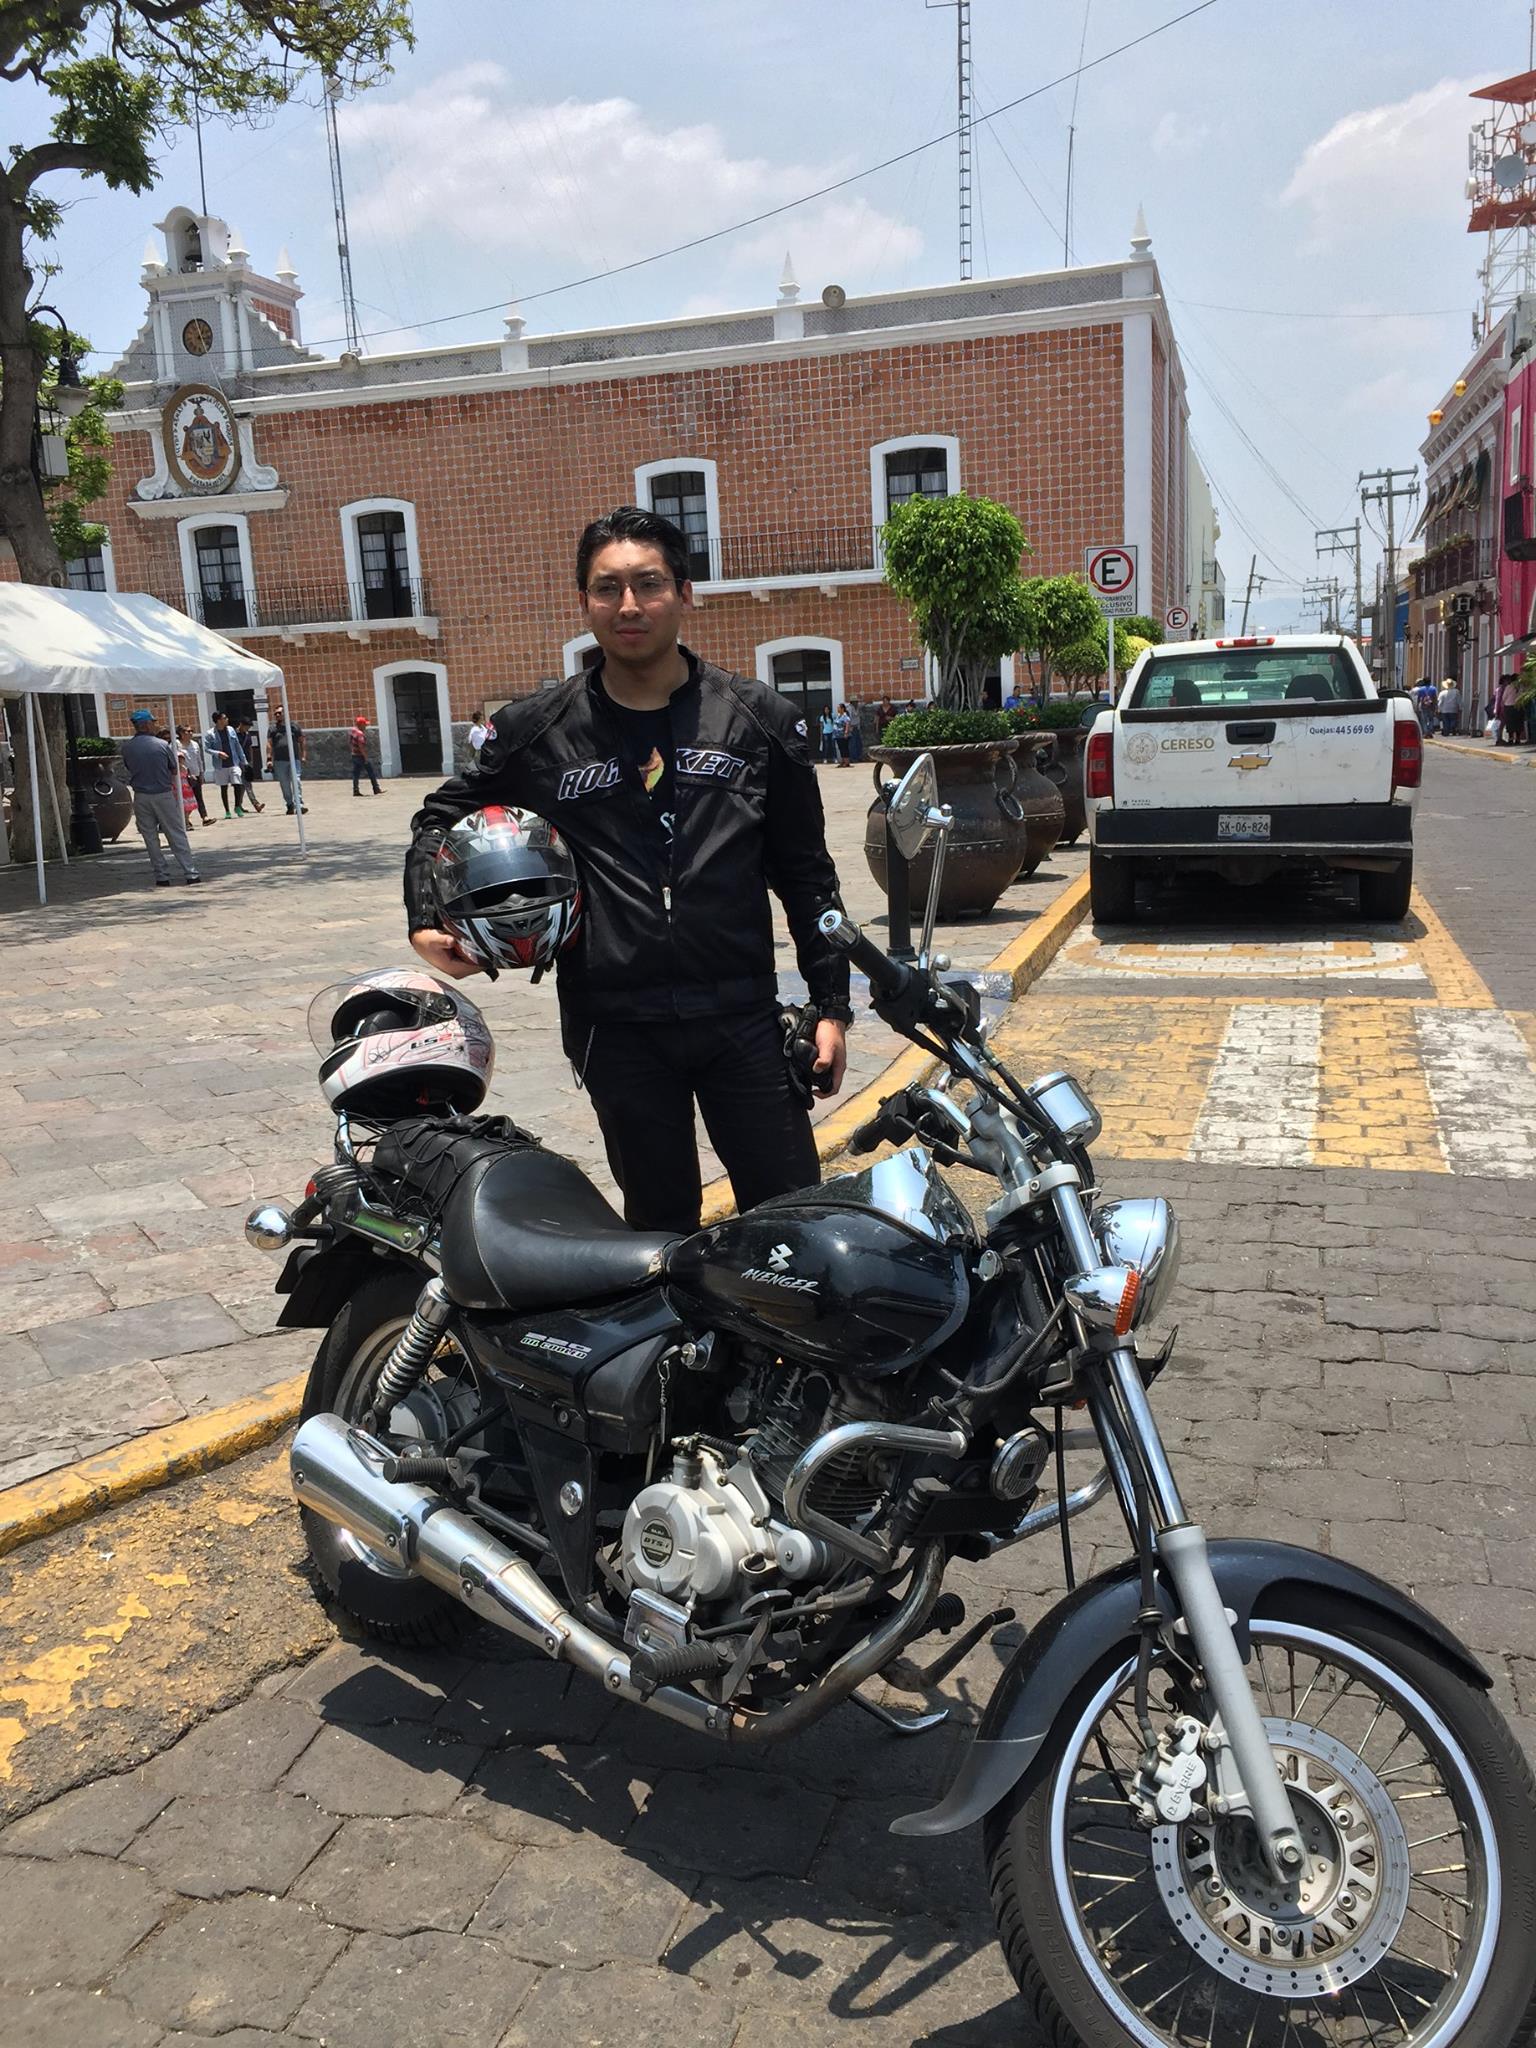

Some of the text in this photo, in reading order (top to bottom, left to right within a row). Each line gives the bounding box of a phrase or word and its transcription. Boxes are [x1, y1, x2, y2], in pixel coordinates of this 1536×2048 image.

[1101, 557, 1122, 586] E
[1456, 598, 1472, 613] H
[1172, 611, 1182, 626] E
[1309, 726, 1336, 736] Quejas:
[1160, 737, 1215, 751] CERESO
[740, 1267, 821, 1295] AVENGER
